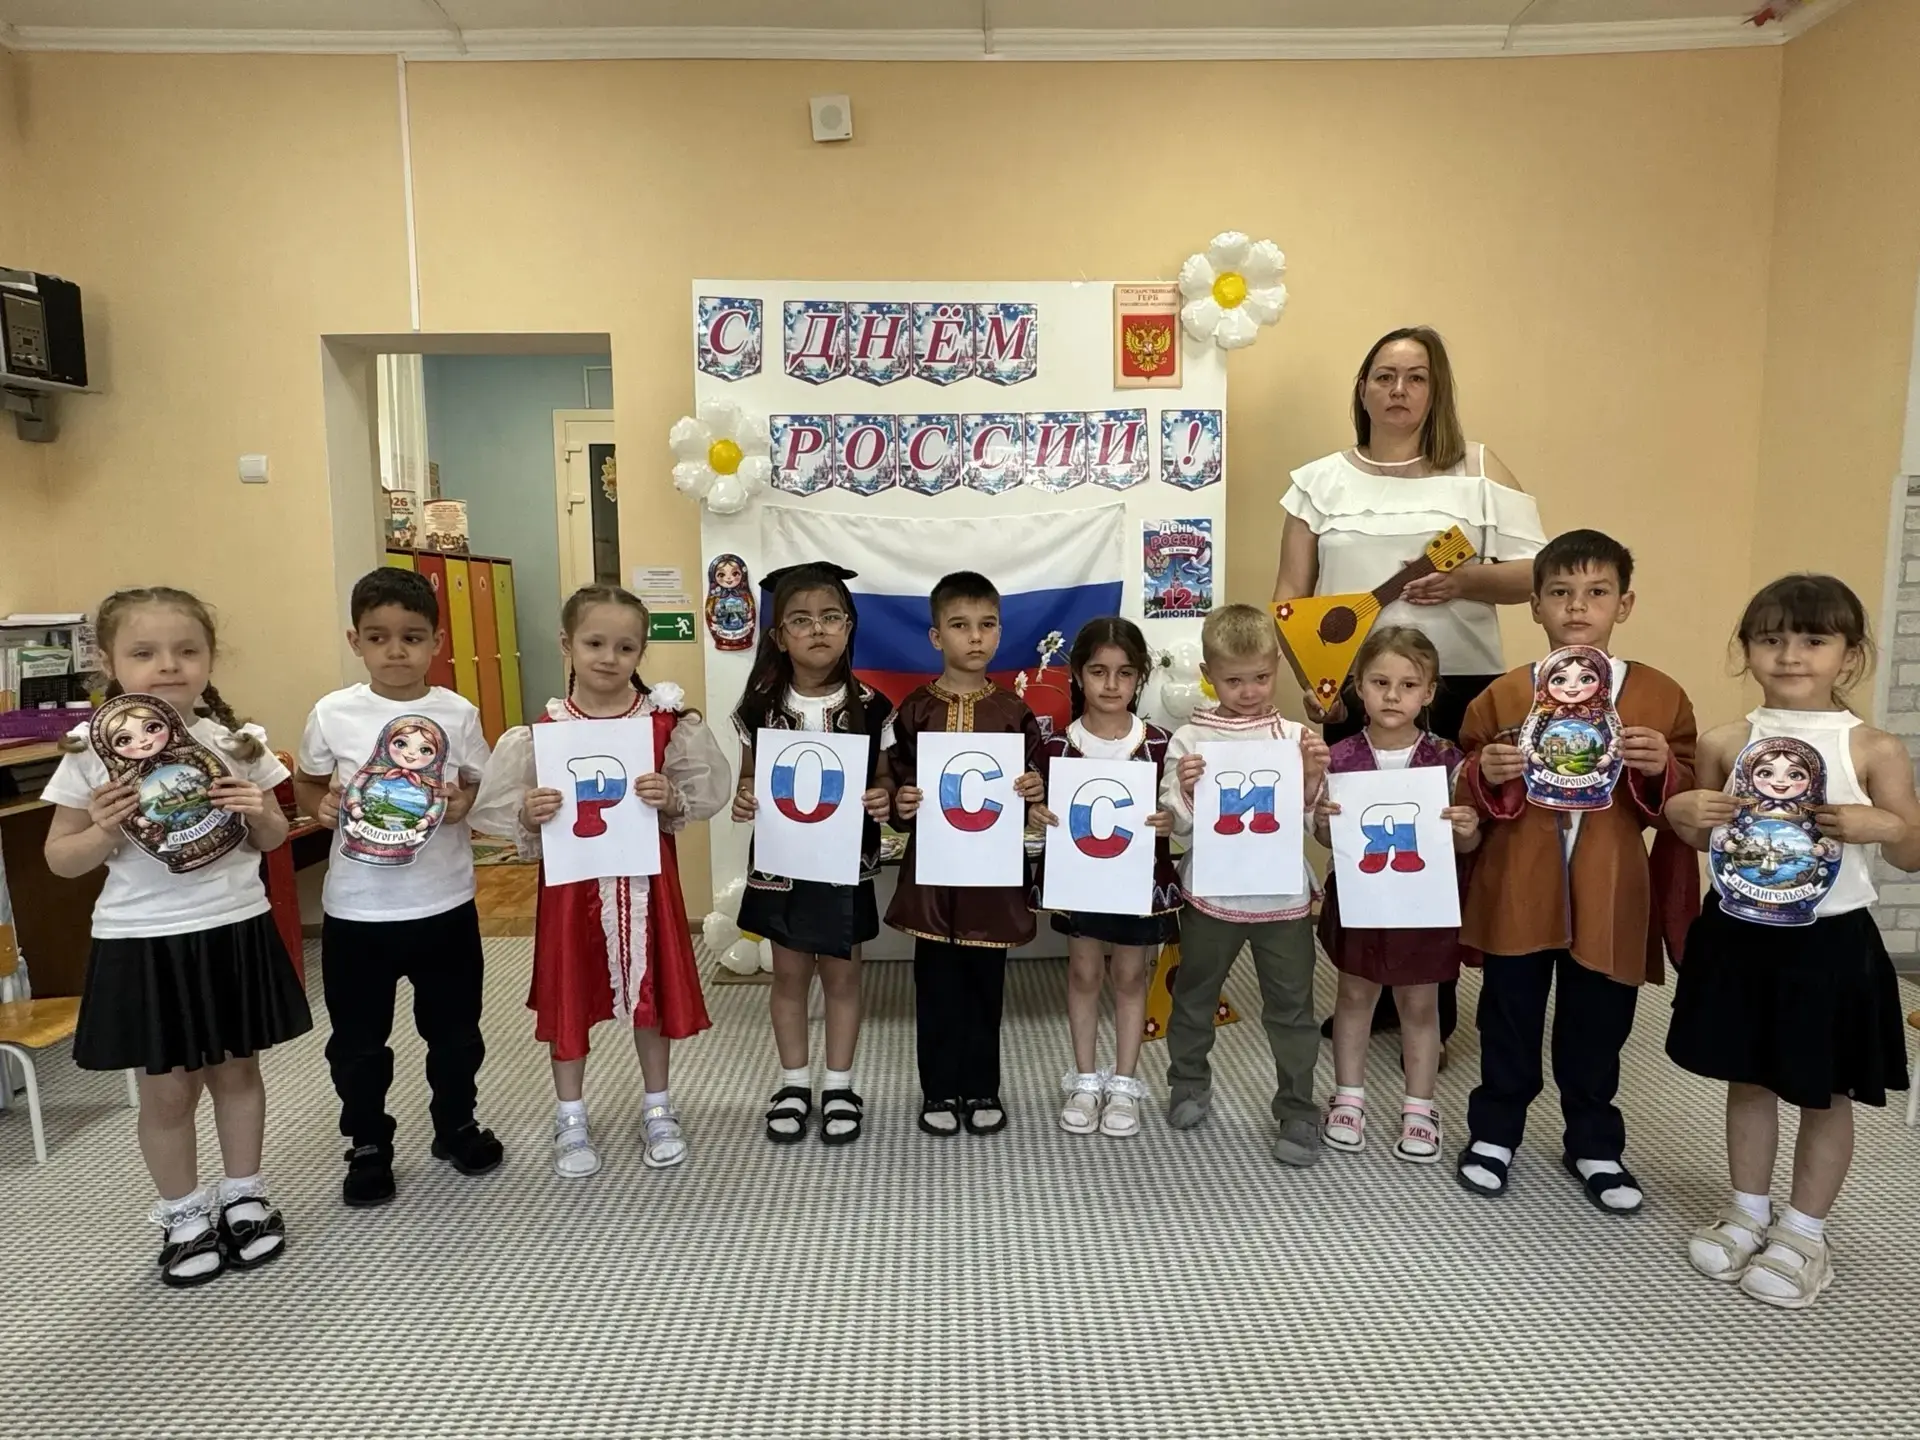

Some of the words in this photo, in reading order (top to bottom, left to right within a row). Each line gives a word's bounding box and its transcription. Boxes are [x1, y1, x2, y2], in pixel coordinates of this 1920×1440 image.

[709, 308, 751, 356] С
[787, 307, 1035, 370] ДНЁМ
[784, 418, 1146, 472] РОССИИ
[1160, 521, 1194, 535] День
[1151, 534, 1206, 549] РОССИИ
[1162, 587, 1193, 609] 12
[1160, 609, 1195, 618] ИЮНЯ
[1543, 771, 1599, 787] СТАВРОПОЛЬ
[171, 810, 222, 843] СМОЛЕНСК
[361, 825, 411, 841] ВОЛГОГРАД
[1733, 879, 1810, 901] АРХАНГЕЛЬСК
